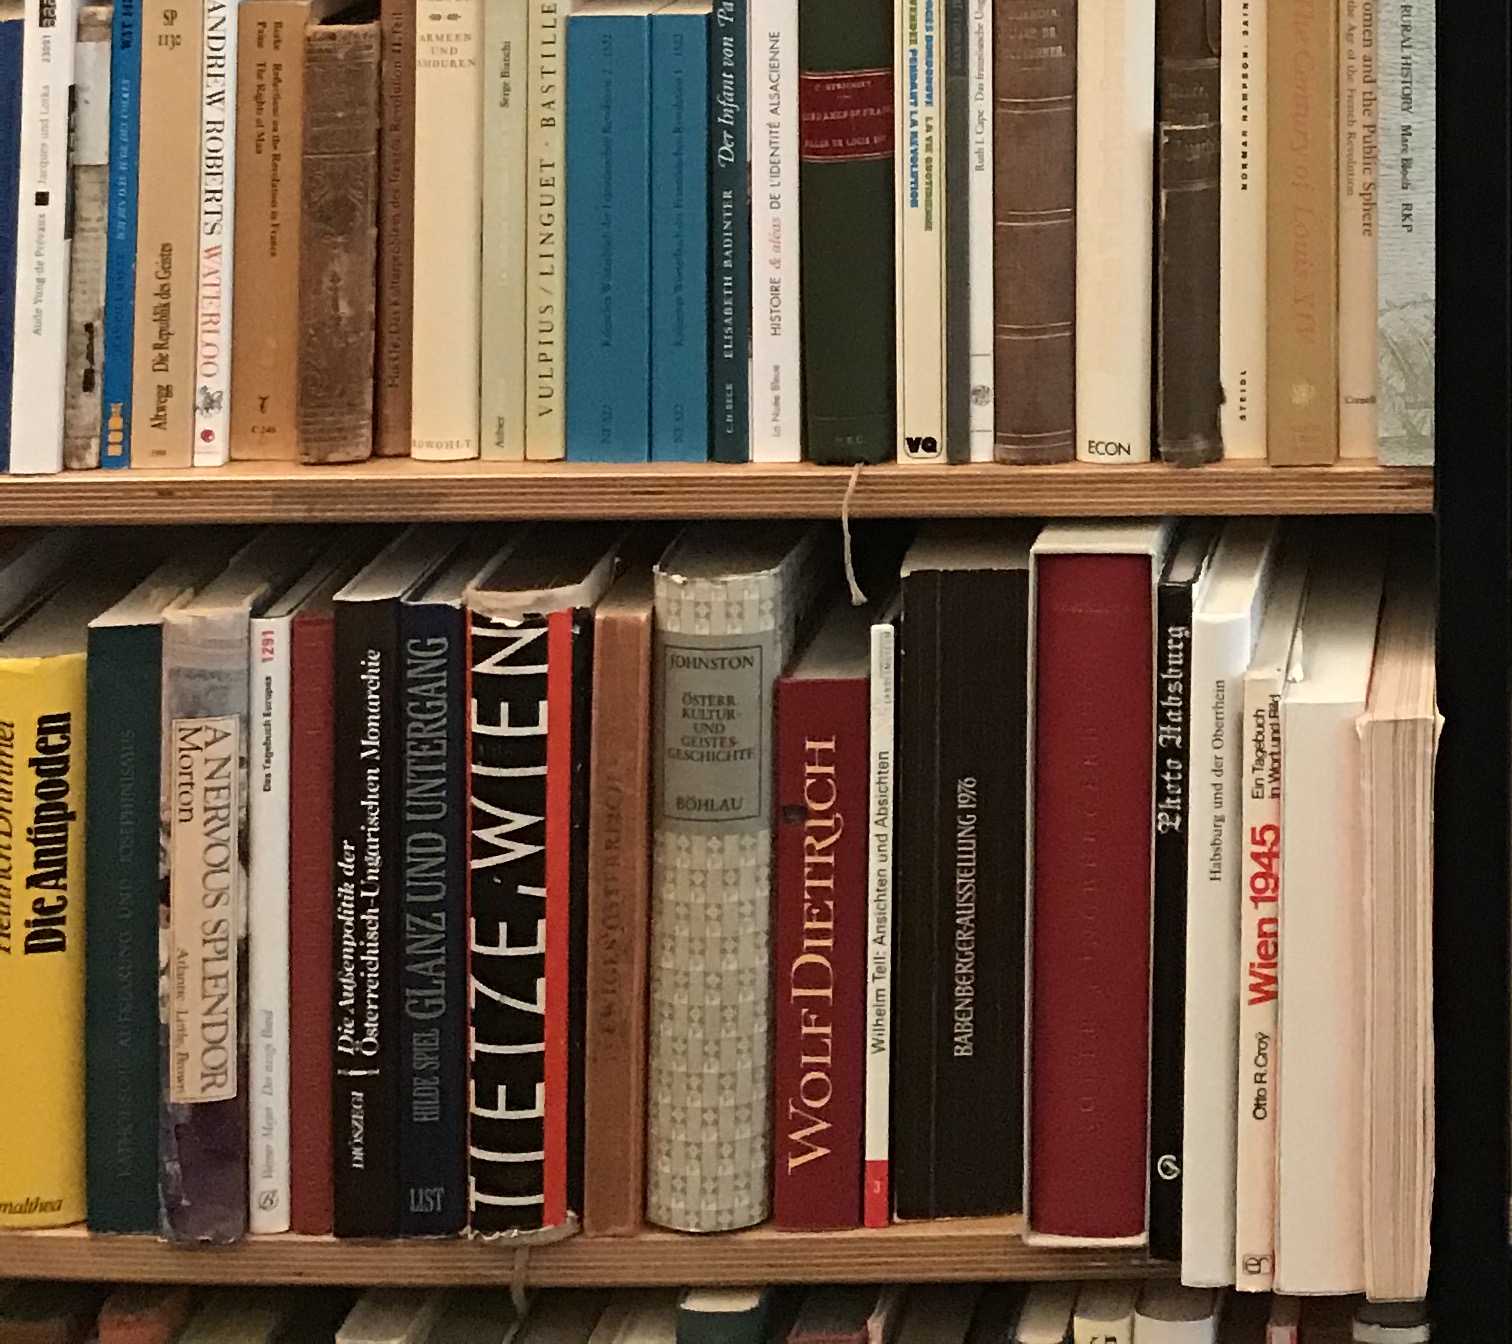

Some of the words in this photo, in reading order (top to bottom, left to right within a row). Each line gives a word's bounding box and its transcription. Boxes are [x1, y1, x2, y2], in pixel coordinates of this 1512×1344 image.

[205, 0, 226, 112] ANDREW
[540, 2, 557, 129] BASTILLE
[1360, 60, 1375, 85] and
[1360, 89, 1375, 115] the
[203, 120, 225, 236] ROBERTS
[1359, 120, 1376, 176] Public
[540, 158, 556, 277] LINGUET
[1360, 183, 1376, 237] Sphere
[200, 244, 222, 377] WATERLOO
[538, 303, 555, 417] VULPIUS
[1088, 442, 1131, 456] ECON
[204, 723, 230, 749] A
[406, 637, 448, 822] UNTERGANG
[1210, 679, 1225, 749] Oberrhein
[1211, 754, 1227, 777] der
[1211, 783, 1225, 808] und
[24, 712, 75, 891] Antipoden
[201, 757, 230, 906] NERVOUS
[406, 831, 446, 902] UND
[1209, 814, 1229, 883] Habsburg
[23, 894, 66, 956] Die
[199, 913, 227, 1089] SPLENDOR
[406, 912, 446, 1021] GLANZ
[411, 1028, 440, 1071] SPIEL
[411, 1076, 440, 1123] HILDE
